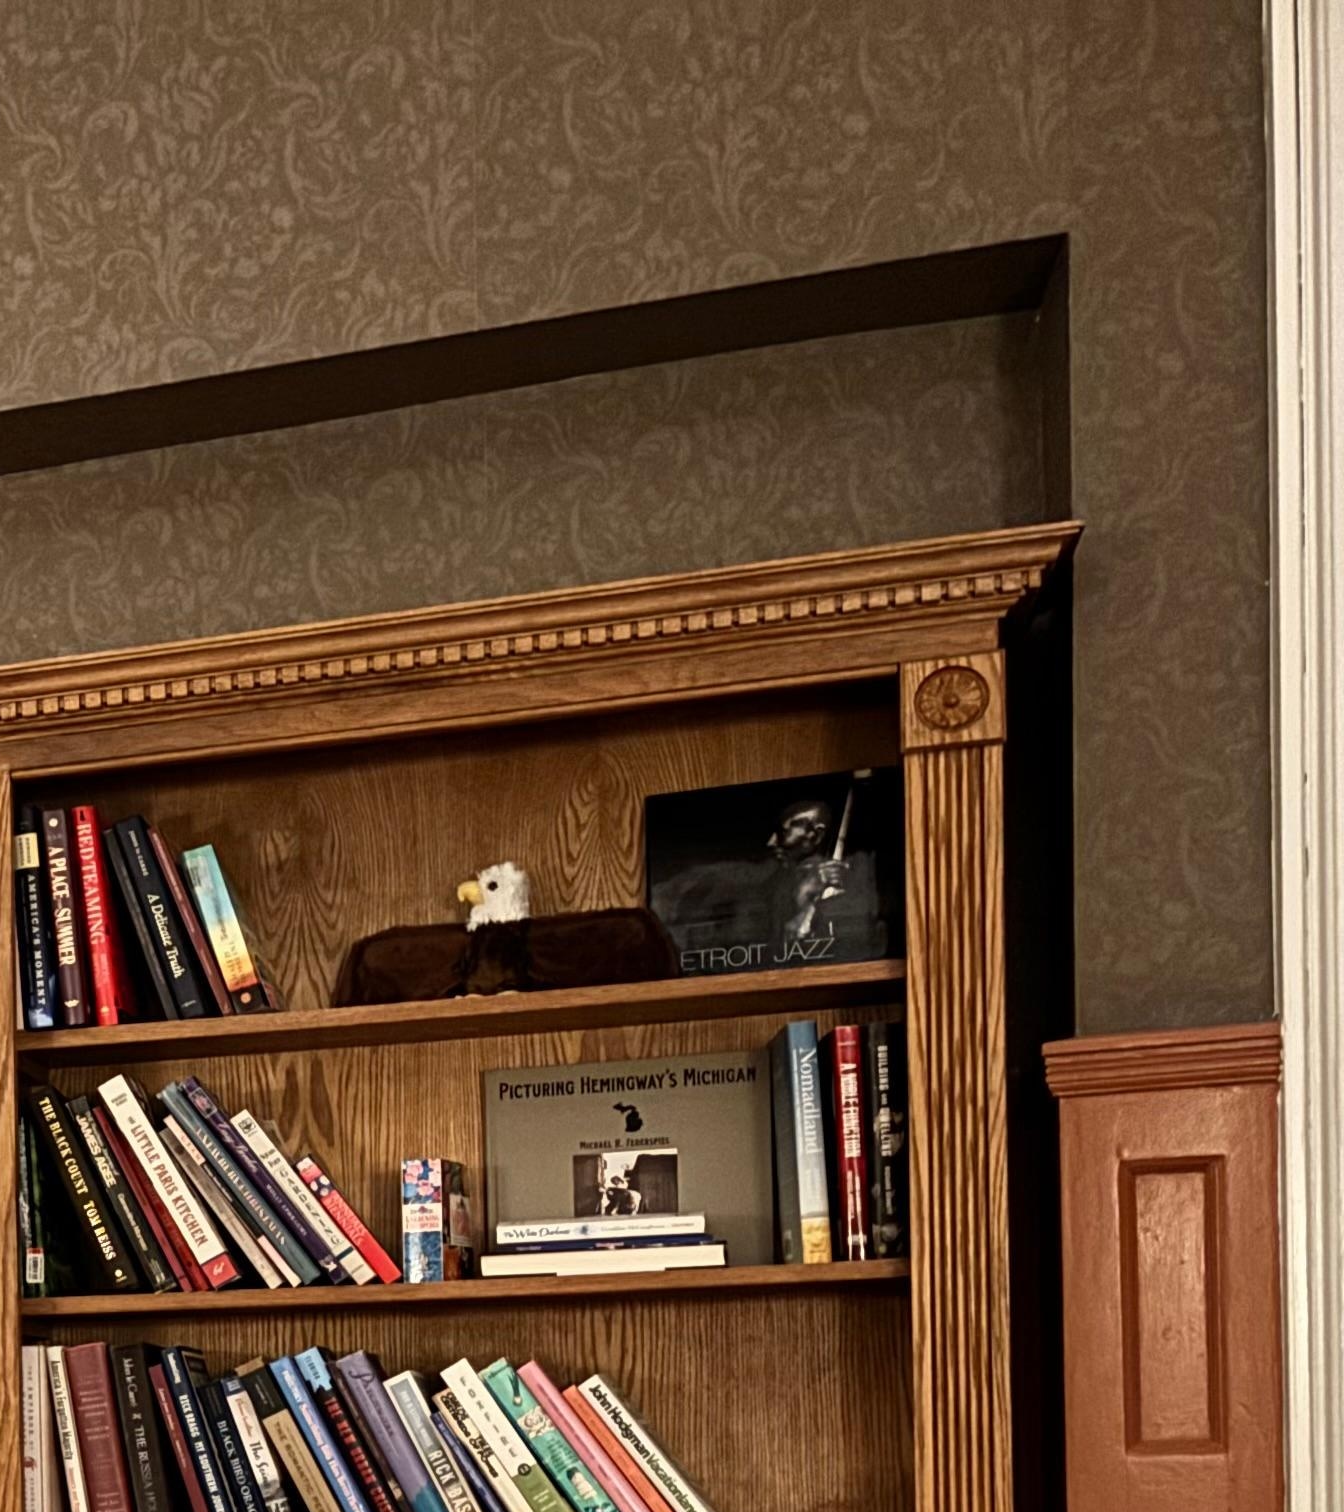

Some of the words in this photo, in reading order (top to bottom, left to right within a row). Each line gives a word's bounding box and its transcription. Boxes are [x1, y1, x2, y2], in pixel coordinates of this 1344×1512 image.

[75, 822, 96, 861] RED
[49, 857, 69, 900] PLACE
[146, 891, 161, 904] A
[26, 873, 41, 944] AMERICA'S
[79, 860, 107, 945] TEAMING
[149, 902, 176, 947] Delicate
[53, 907, 76, 966] SUMMER
[680, 944, 766, 971] ETROIT
[773, 937, 835, 963] JAZZ
[32, 949, 46, 1005] MOMENT
[164, 945, 186, 979] Truth
[499, 1080, 575, 1101] PICTURING
[580, 1070, 677, 1096] HEMINGWAY'S
[683, 1066, 757, 1088] MICHIGAN
[799, 1048, 823, 1155] Nomadland
[37, 1096, 57, 1122] THE
[47, 1120, 73, 1158] BLACK
[63, 1157, 89, 1196] COUNT
[74, 1111, 102, 1156] JAMES
[94, 1153, 117, 1188] AGEE
[128, 1123, 161, 1164] LITTLE
[151, 1161, 180, 1196] PARIS
[169, 1193, 211, 1247] KITCHEN
[81, 1199, 102, 1227] TOM
[93, 1225, 117, 1261] REISS
[178, 1393, 192, 1412] RICK
[184, 1412, 200, 1438] BRAGG
[587, 1380, 615, 1411] John
[604, 1405, 653, 1460] Hodgman
[60, 1430, 75, 1460] Majority
[133, 1424, 147, 1448] THE
[216, 1419, 238, 1457] BLACK
[229, 1456, 248, 1486] BIRD
[248, 1439, 267, 1461] The
[323, 1396, 343, 1419] THE
[335, 1419, 357, 1447] NEW
[348, 1445, 377, 1486] URBAN
[137, 1449, 154, 1488] RUSSIA
[283, 1441, 314, 1496] ROMANTIC
[426, 1447, 456, 1485] RICK
